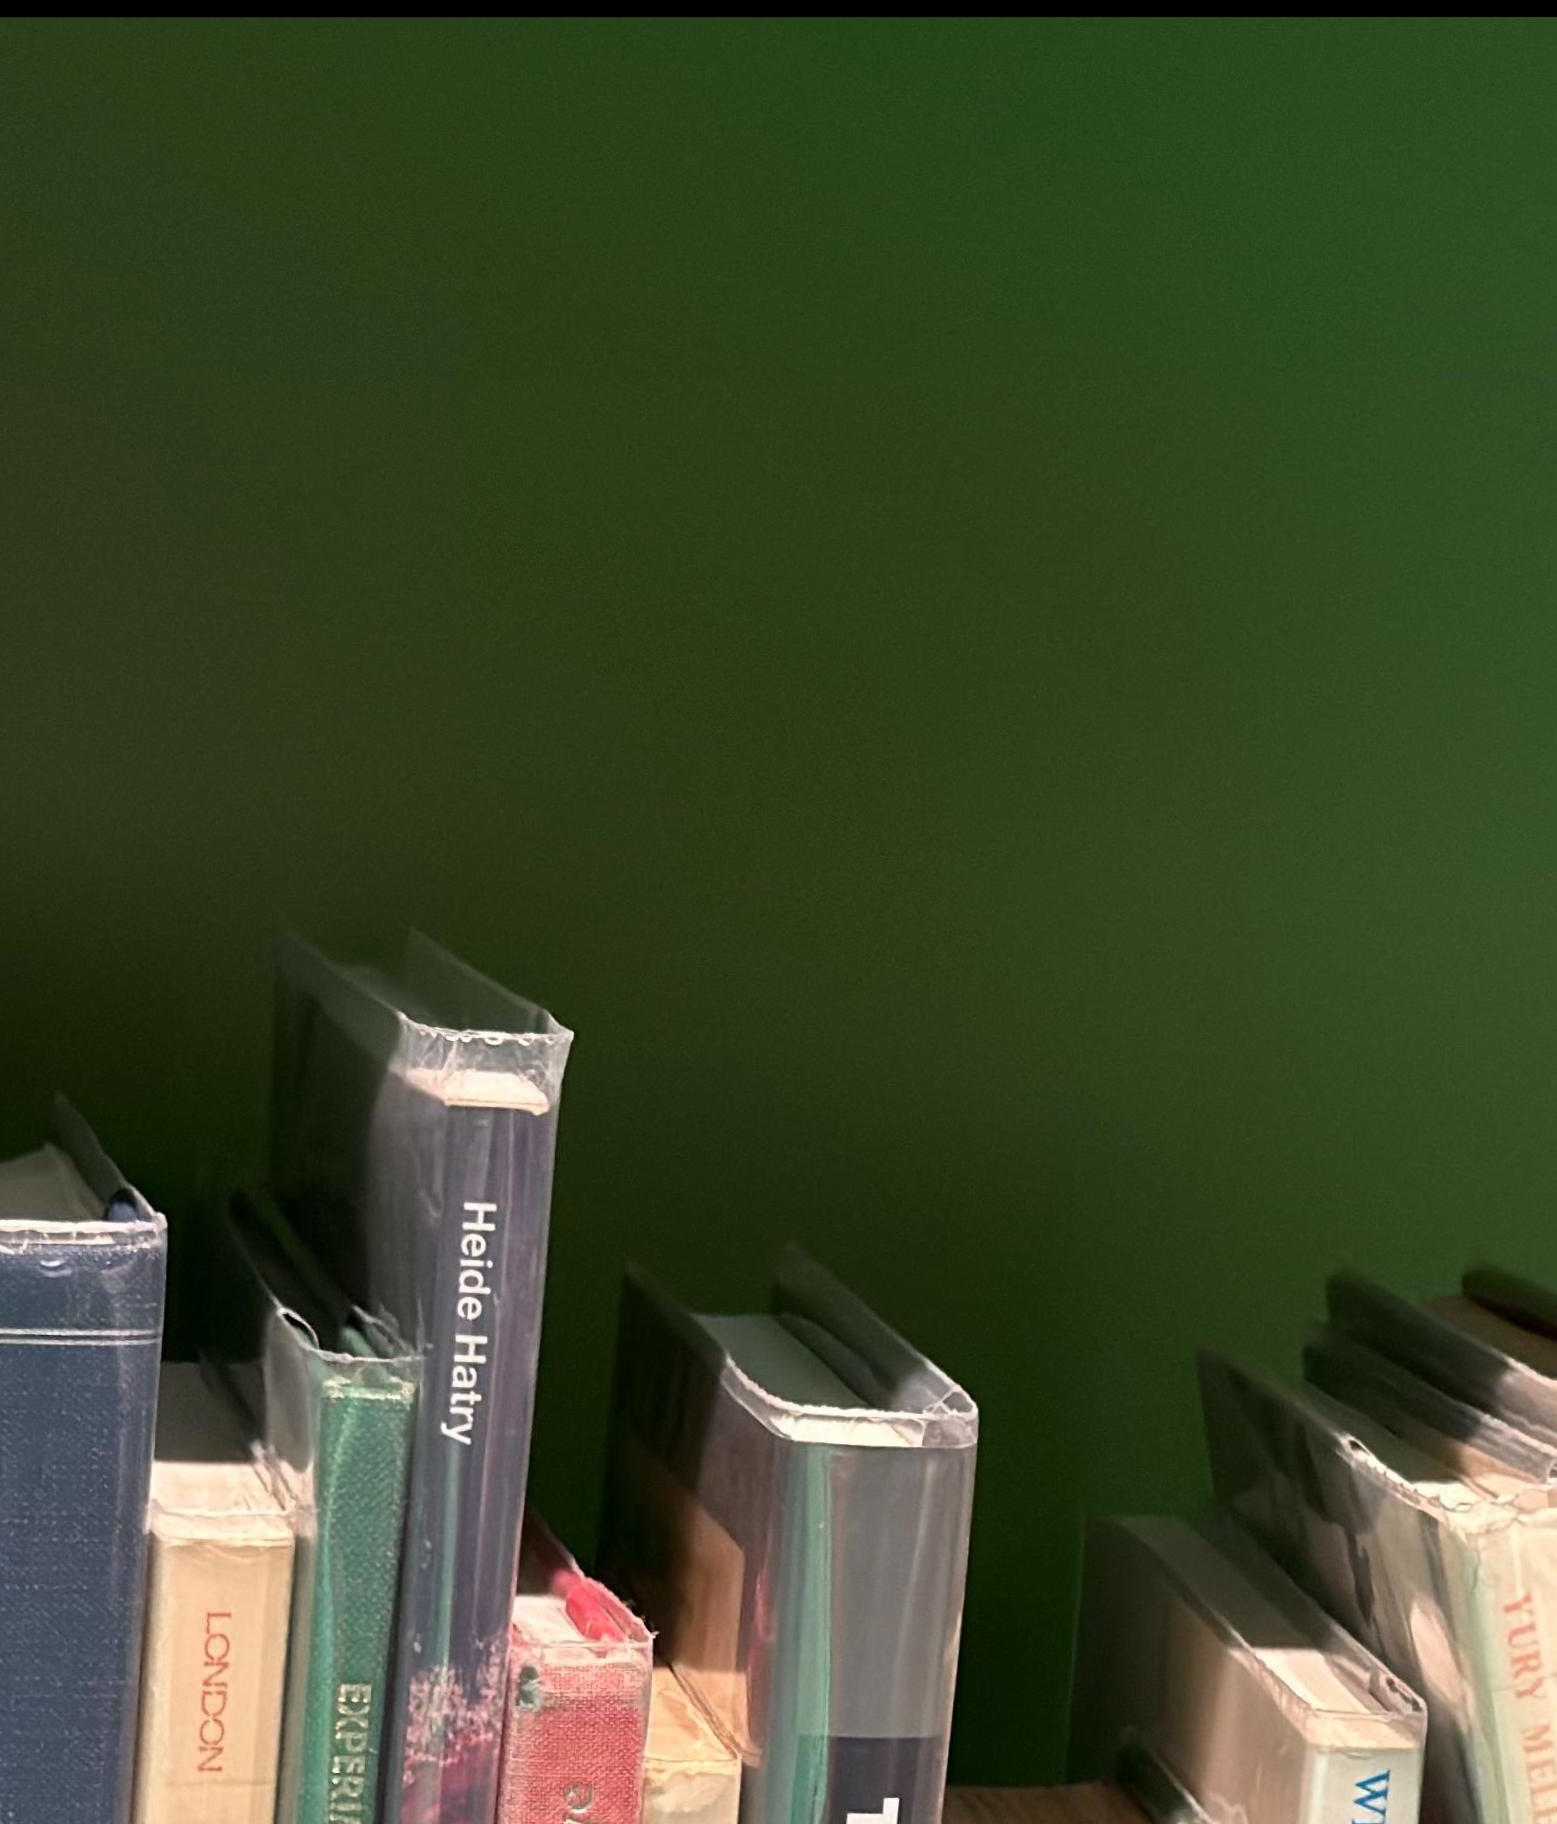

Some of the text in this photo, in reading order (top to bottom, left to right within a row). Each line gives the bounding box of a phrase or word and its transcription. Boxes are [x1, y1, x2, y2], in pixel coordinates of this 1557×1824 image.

[441, 1202, 496, 1445] Heide Hatry
[198, 1611, 231, 1772] LONDON
